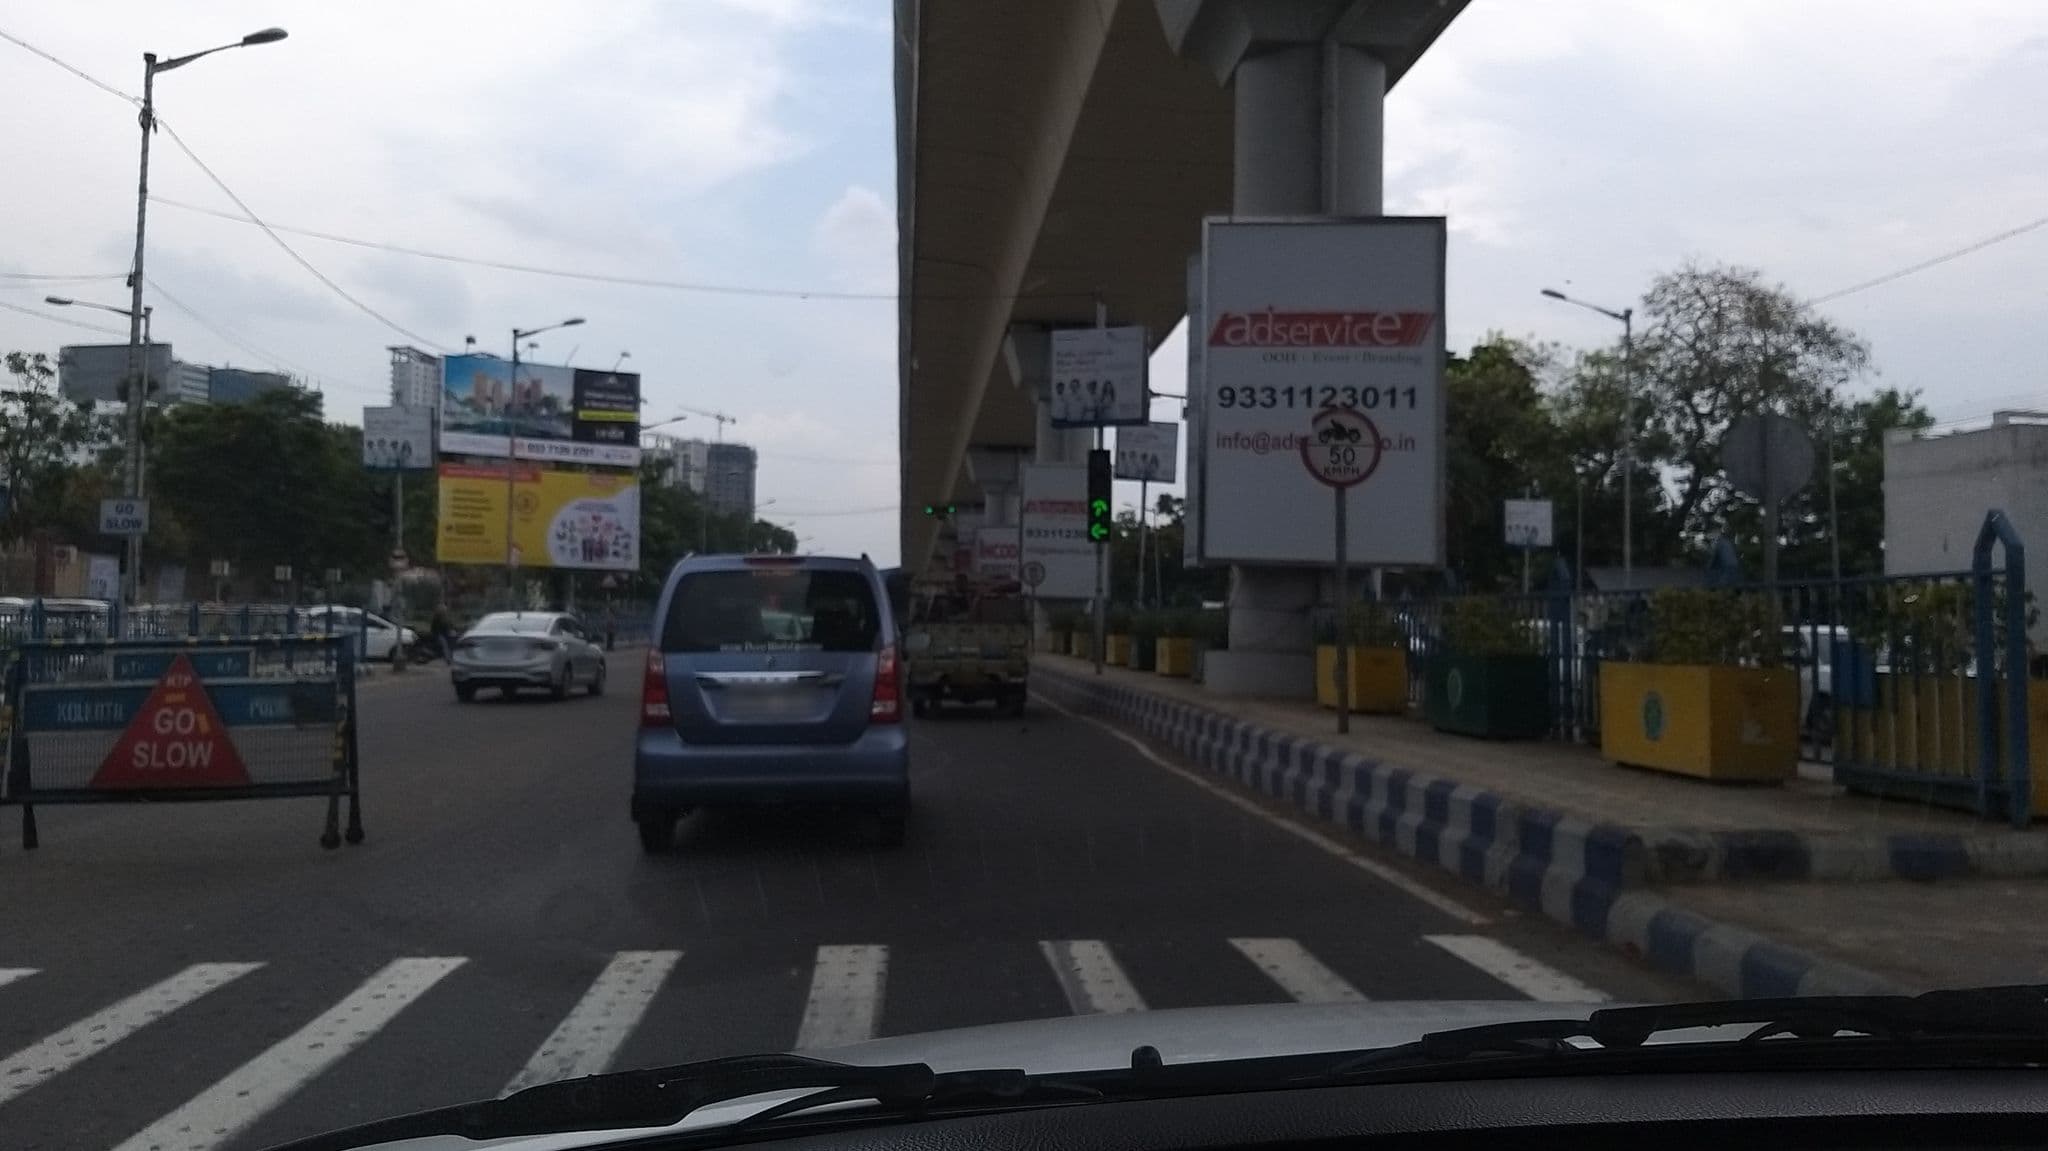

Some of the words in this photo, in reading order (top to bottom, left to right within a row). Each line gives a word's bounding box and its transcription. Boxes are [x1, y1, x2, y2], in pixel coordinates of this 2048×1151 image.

[1222, 307, 1402, 347] adservice
[1217, 385, 1417, 409] 9331123011
[1329, 448, 1356, 467] 50
[1323, 467, 1360, 476] KMPH
[115, 503, 135, 515] GO
[106, 518, 143, 529] SLOW
[155, 708, 196, 735] GO
[133, 741, 214, 768] SLOW
